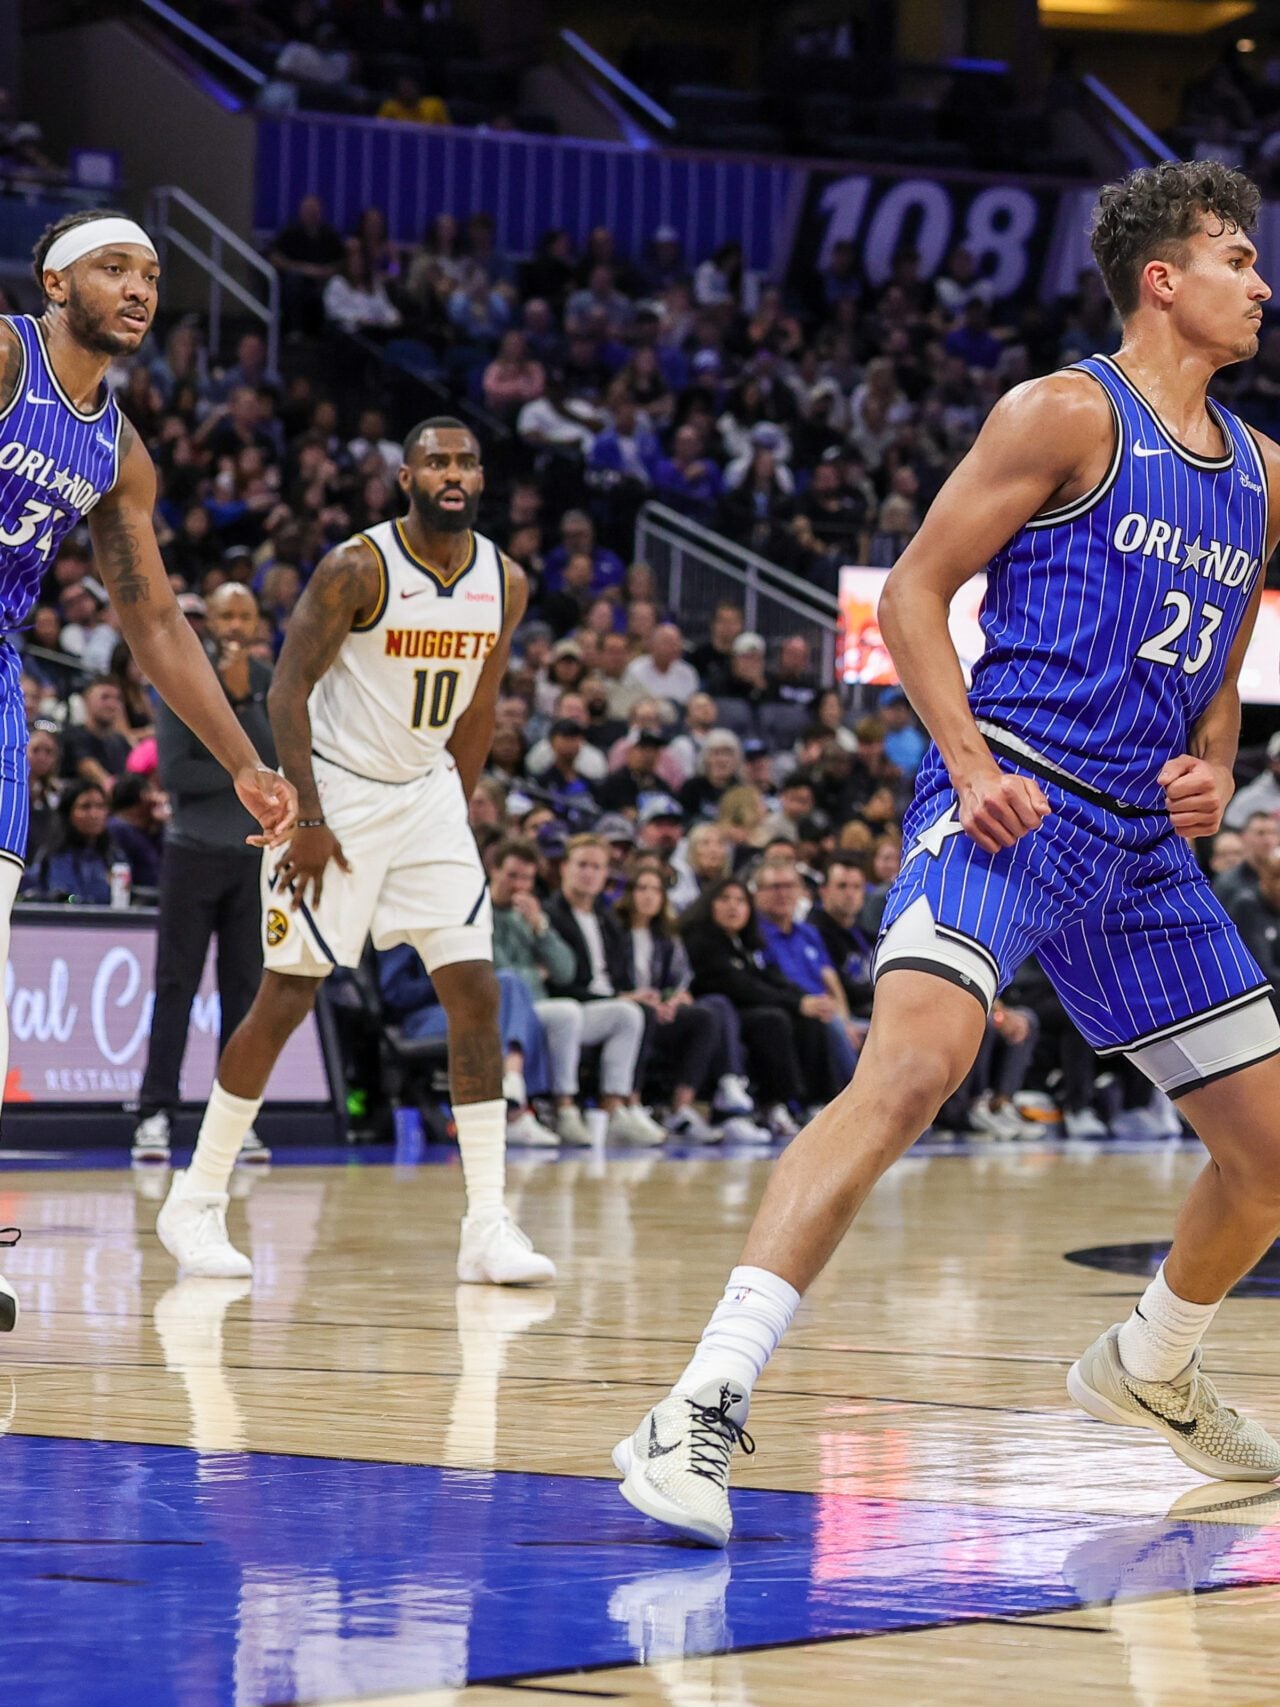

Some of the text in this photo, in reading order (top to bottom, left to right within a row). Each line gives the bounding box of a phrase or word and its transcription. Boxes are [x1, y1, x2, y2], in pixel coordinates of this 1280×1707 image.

[817, 175, 1038, 297] 108
[1136, 590, 1224, 674] 23
[411, 668, 460, 730] 10
